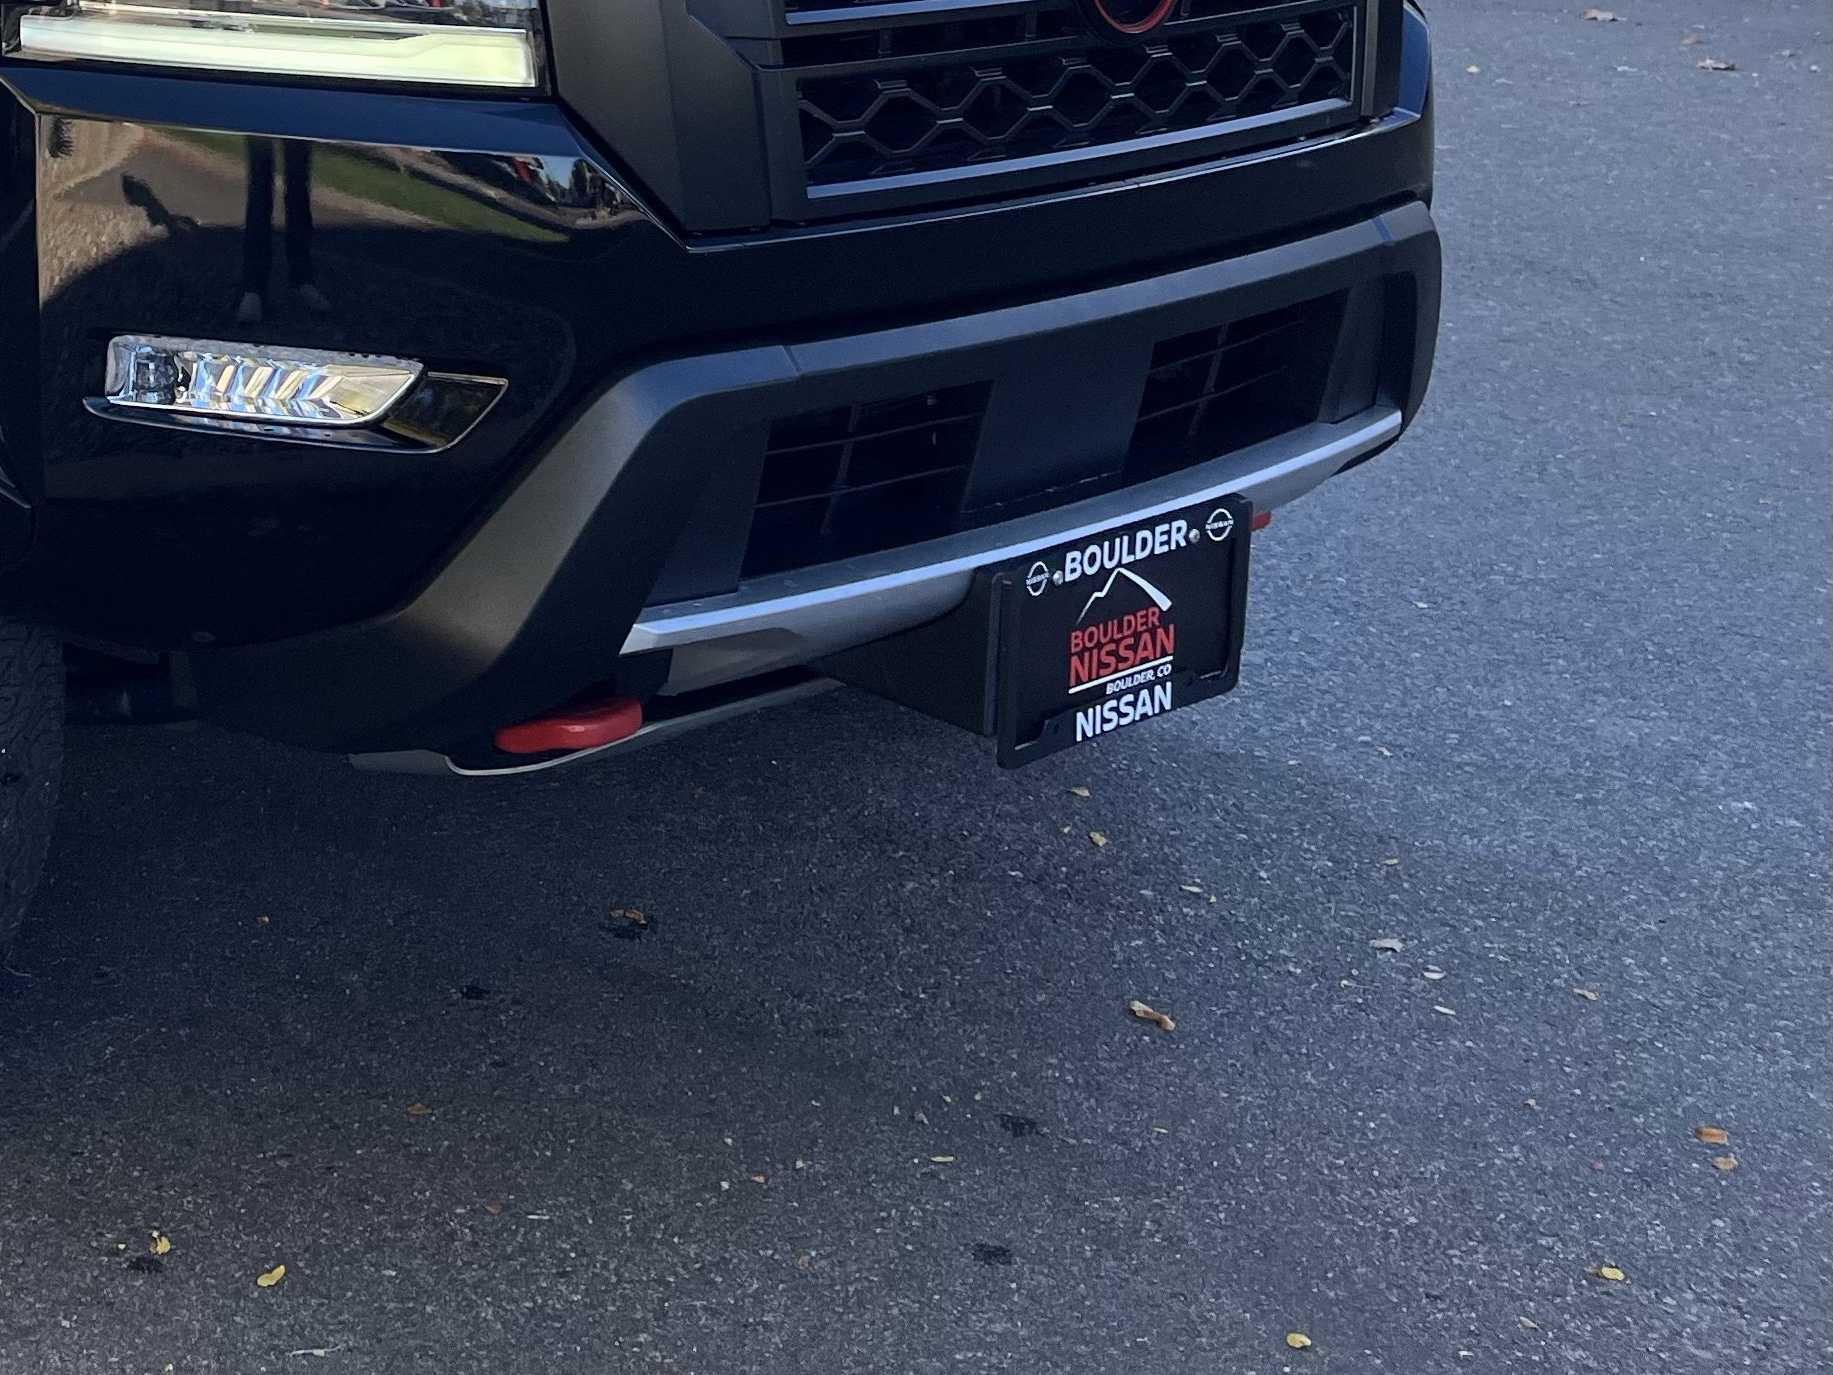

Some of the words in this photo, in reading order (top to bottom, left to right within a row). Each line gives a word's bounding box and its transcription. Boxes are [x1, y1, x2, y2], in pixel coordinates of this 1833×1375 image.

[1064, 519, 1188, 582] BOULDER
[1069, 624, 1175, 687] NISSAN
[1070, 606, 1160, 653] BOULDER
[1075, 681, 1172, 742] NISSAN
